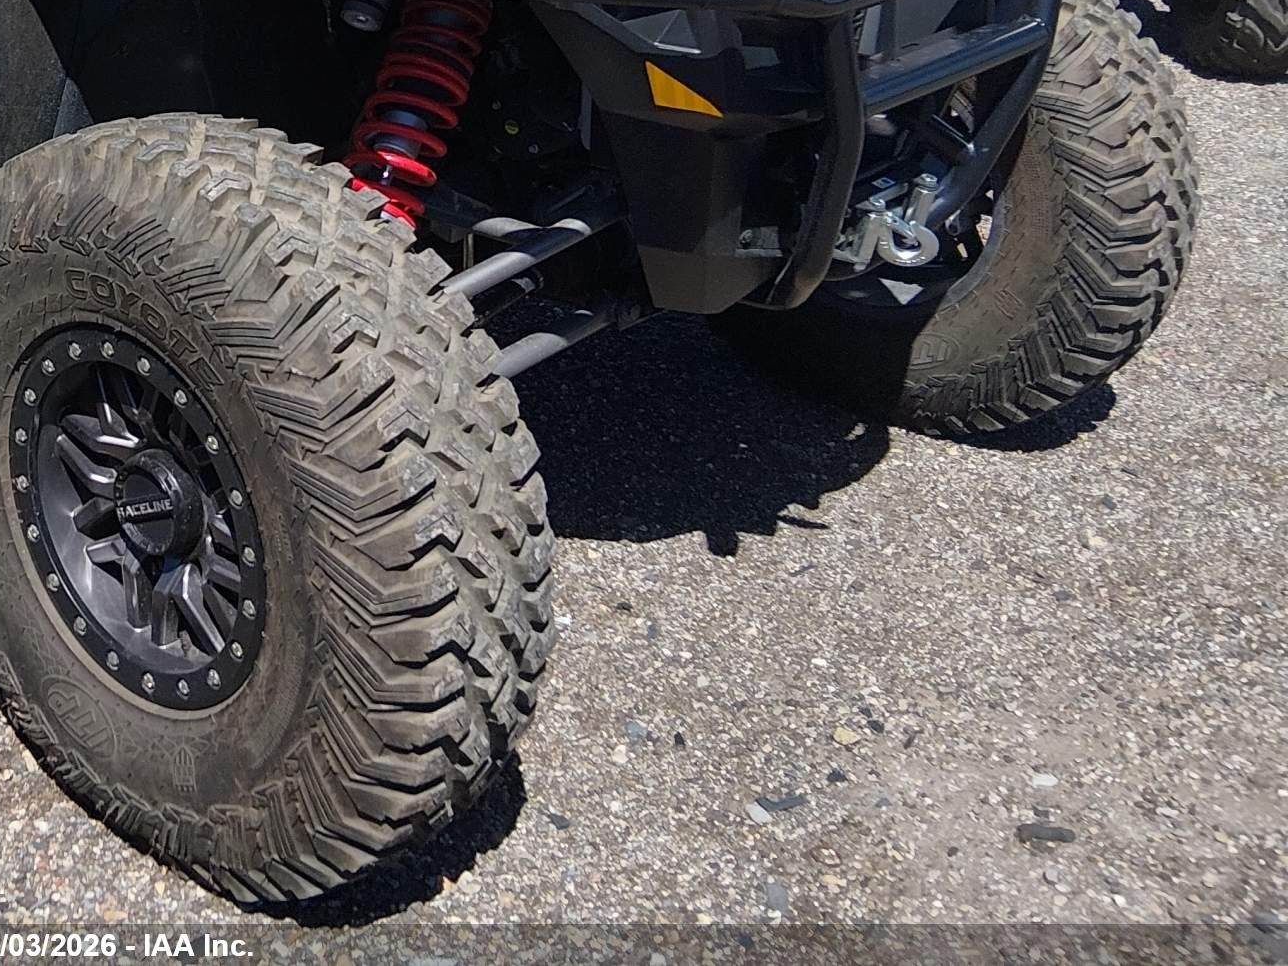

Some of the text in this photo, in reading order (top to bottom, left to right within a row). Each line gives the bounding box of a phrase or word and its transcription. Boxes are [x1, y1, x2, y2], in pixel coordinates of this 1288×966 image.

[64, 267, 224, 391] COYOTE
[115, 498, 174, 519] RACELINE
[47, 686, 112, 749] ITP
